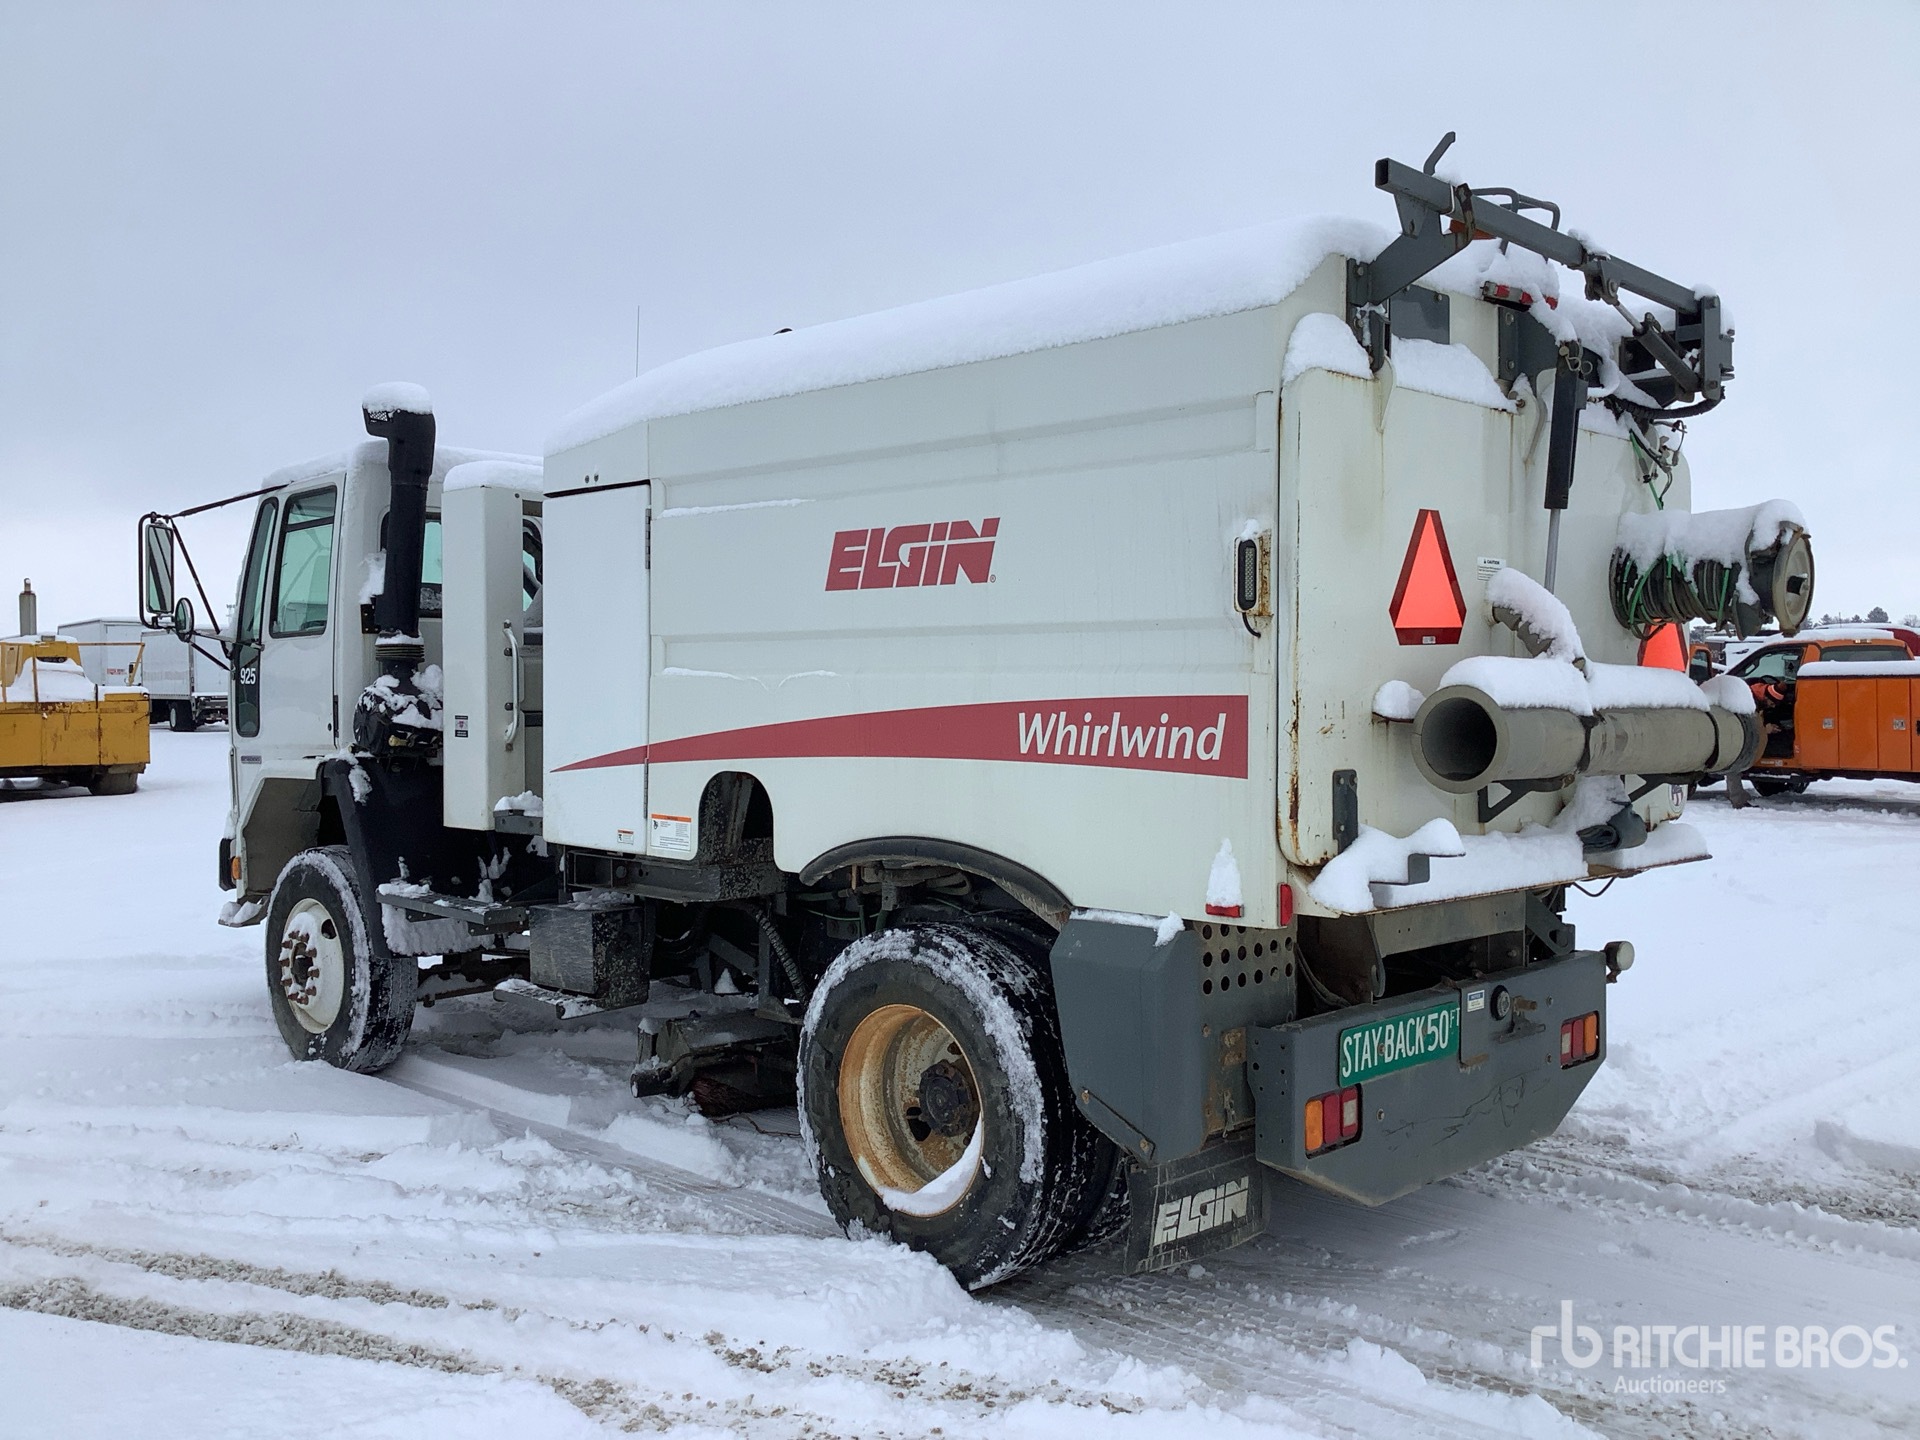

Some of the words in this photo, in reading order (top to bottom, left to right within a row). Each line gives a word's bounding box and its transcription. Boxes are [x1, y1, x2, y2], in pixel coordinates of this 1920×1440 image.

[825, 517, 1000, 591] ELGIN
[240, 667, 256, 685] 925
[1018, 711, 1227, 760] Whirlwind
[1342, 1026, 1382, 1078] STAY
[1384, 1016, 1425, 1063] BACK
[1427, 1010, 1449, 1051] 50
[1450, 1007, 1460, 1028] FT
[1153, 1176, 1249, 1247] ELGIN
